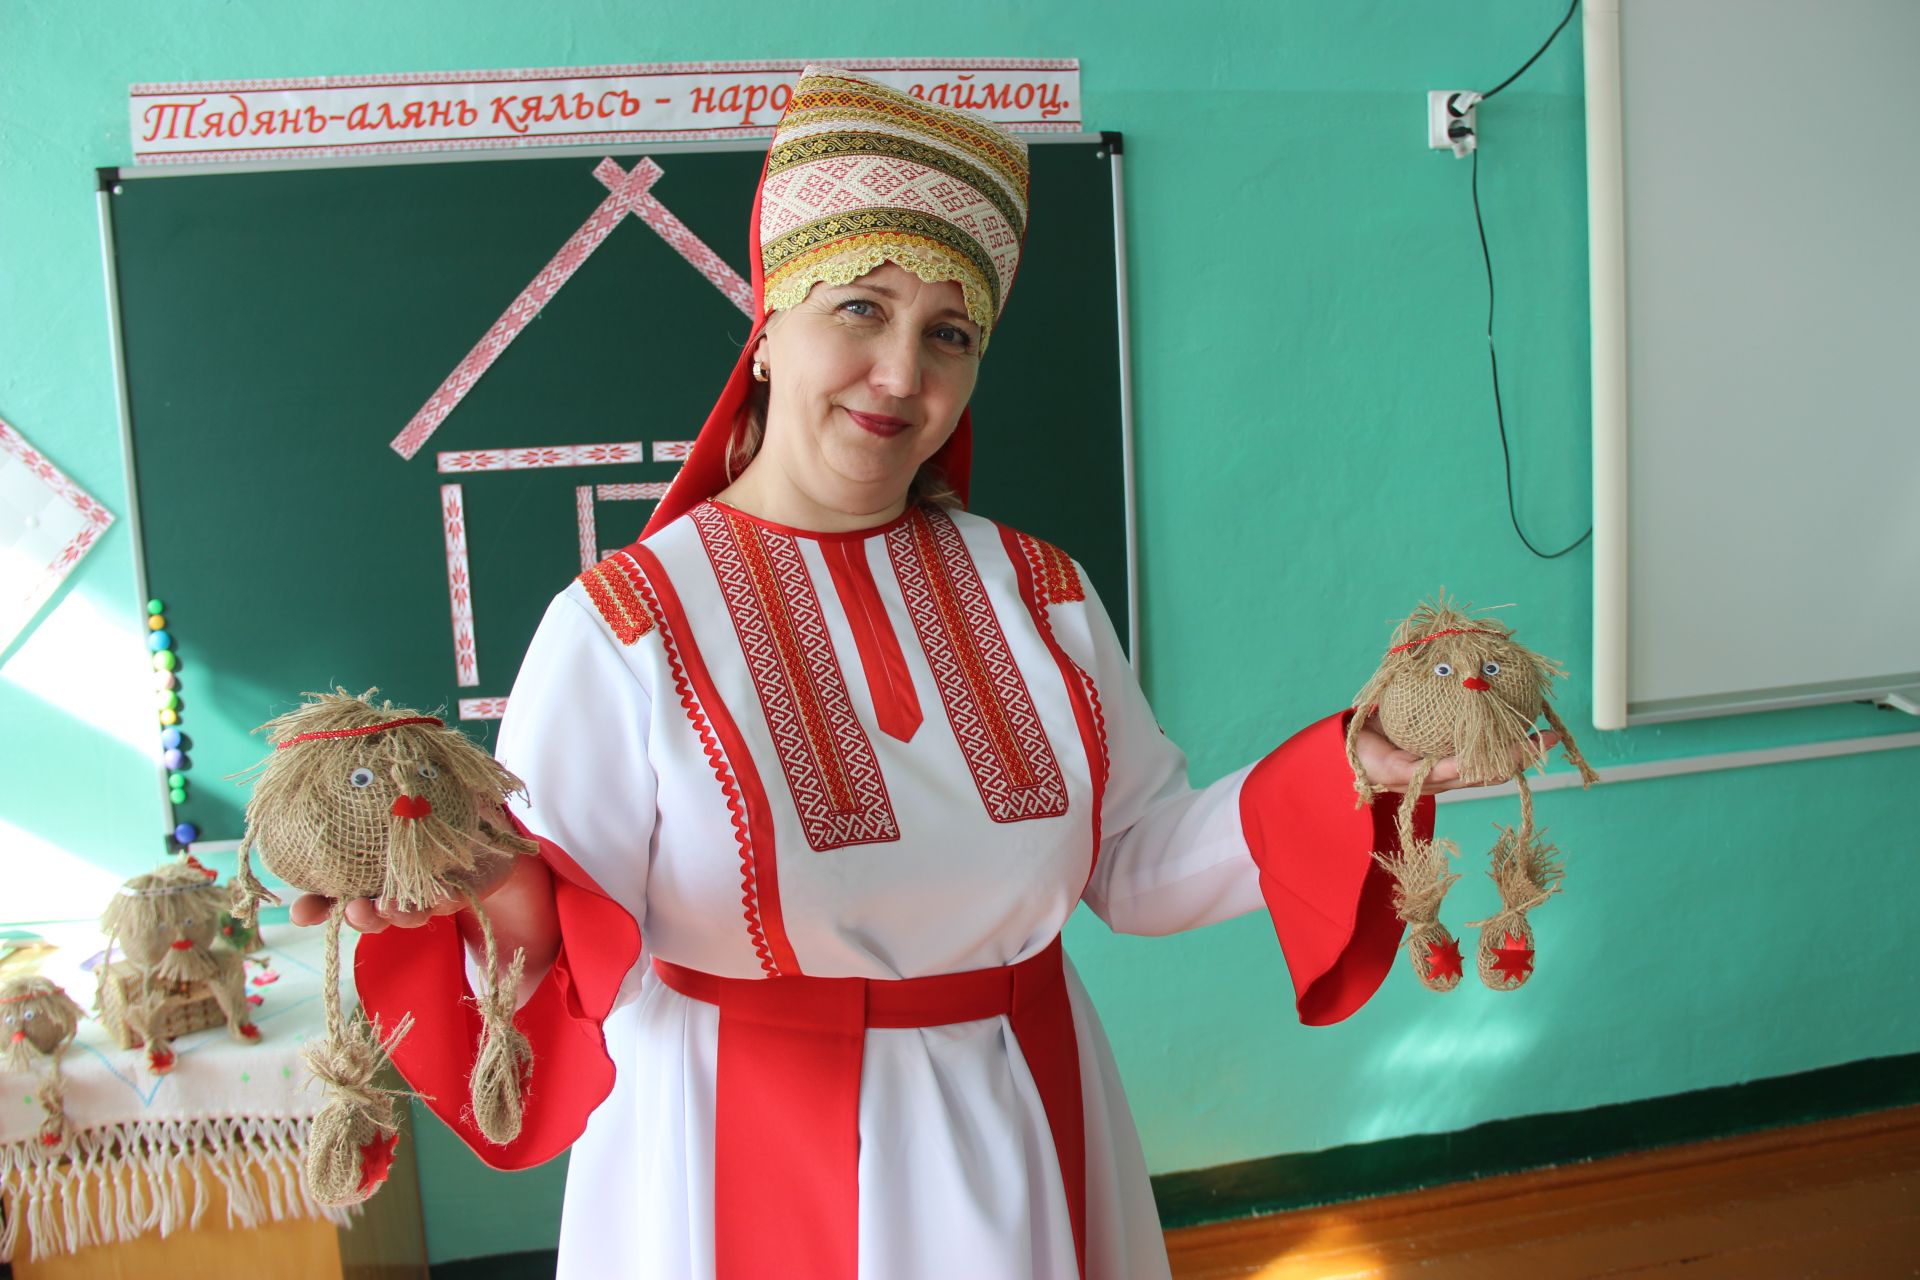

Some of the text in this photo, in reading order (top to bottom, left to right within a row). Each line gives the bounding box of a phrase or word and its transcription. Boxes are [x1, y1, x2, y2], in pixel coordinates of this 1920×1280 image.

[143, 95, 478, 142] Тядянь-алянь
[490, 90, 641, 133] кяльсь
[690, 83, 793, 125] наро
